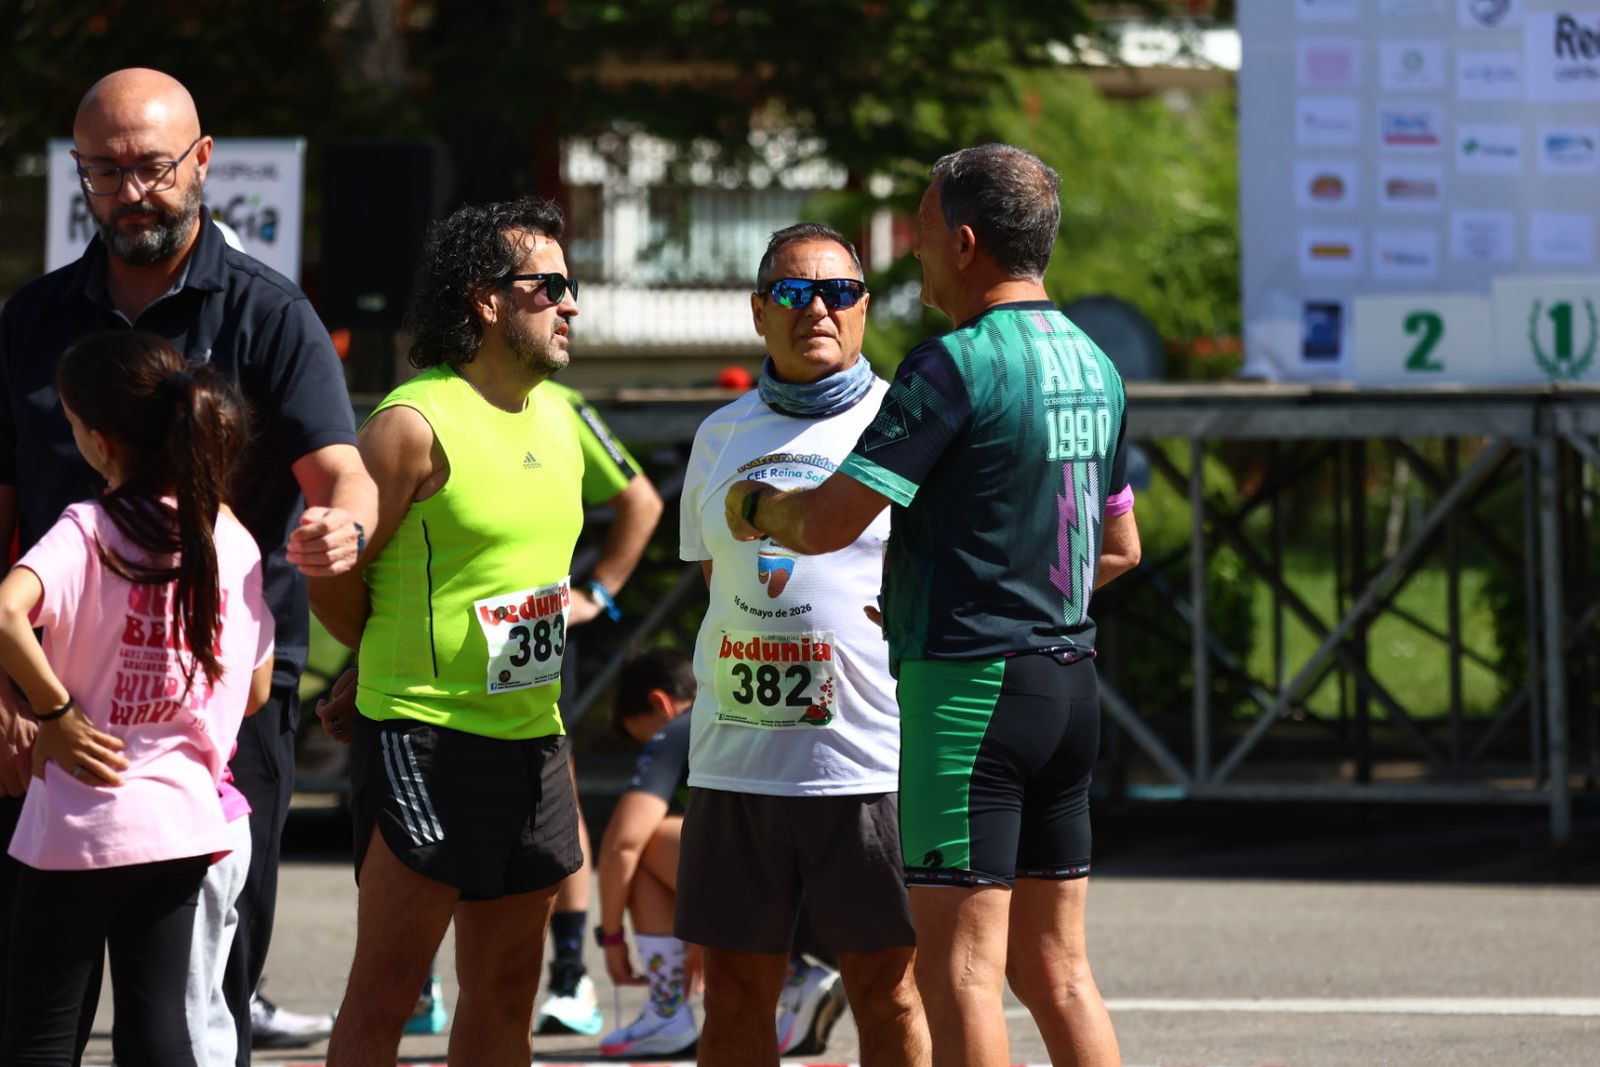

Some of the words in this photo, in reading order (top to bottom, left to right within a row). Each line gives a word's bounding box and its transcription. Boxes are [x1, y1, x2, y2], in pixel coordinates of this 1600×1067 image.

[1403, 309, 1446, 373] 2
[1547, 300, 1574, 363] 1
[1035, 338, 1104, 394] AVS
[1046, 407, 1112, 461] 1990
[747, 469, 767, 480] CEE
[770, 467, 802, 478] Reina
[805, 470, 827, 484] Sof
[795, 453, 839, 473] solidar
[739, 601, 749, 612] de
[749, 607, 773, 619] mayo
[775, 609, 787, 618] de
[789, 603, 812, 617] 2026
[509, 614, 566, 668] 383
[719, 634, 832, 663] bedunia
[731, 662, 813, 707] 382
